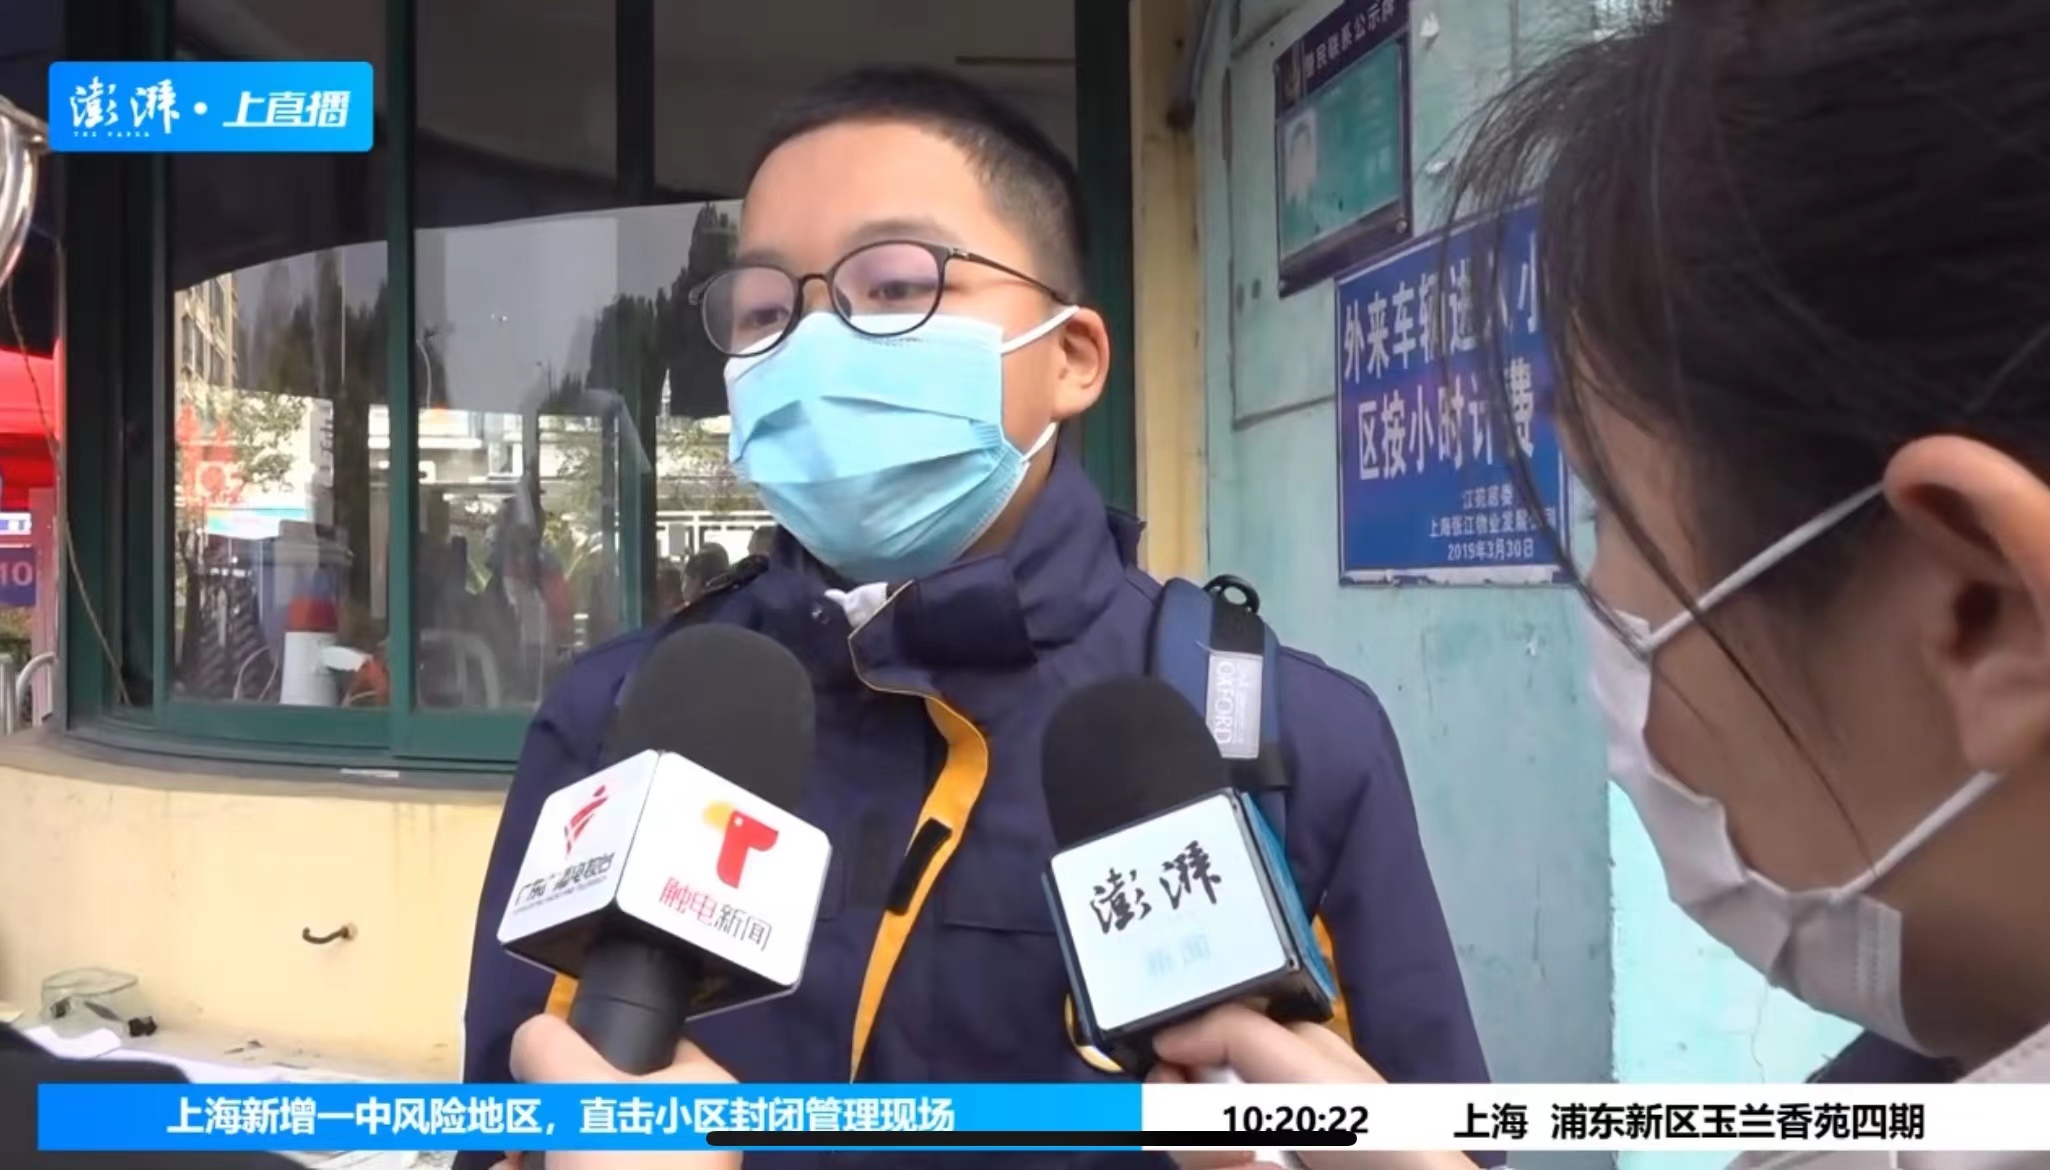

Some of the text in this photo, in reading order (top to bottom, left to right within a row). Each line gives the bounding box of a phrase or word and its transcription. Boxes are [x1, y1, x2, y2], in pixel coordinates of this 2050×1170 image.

[1358, 357, 1535, 480] 区按小时计费
[1447, 537, 1534, 562] 2019年3月30日
[1215, 661, 1235, 744] OXFORD
[514, 851, 615, 907] 广东播电视台
[658, 876, 773, 952] 触电新闻
[1089, 840, 1222, 935] 澎湃
